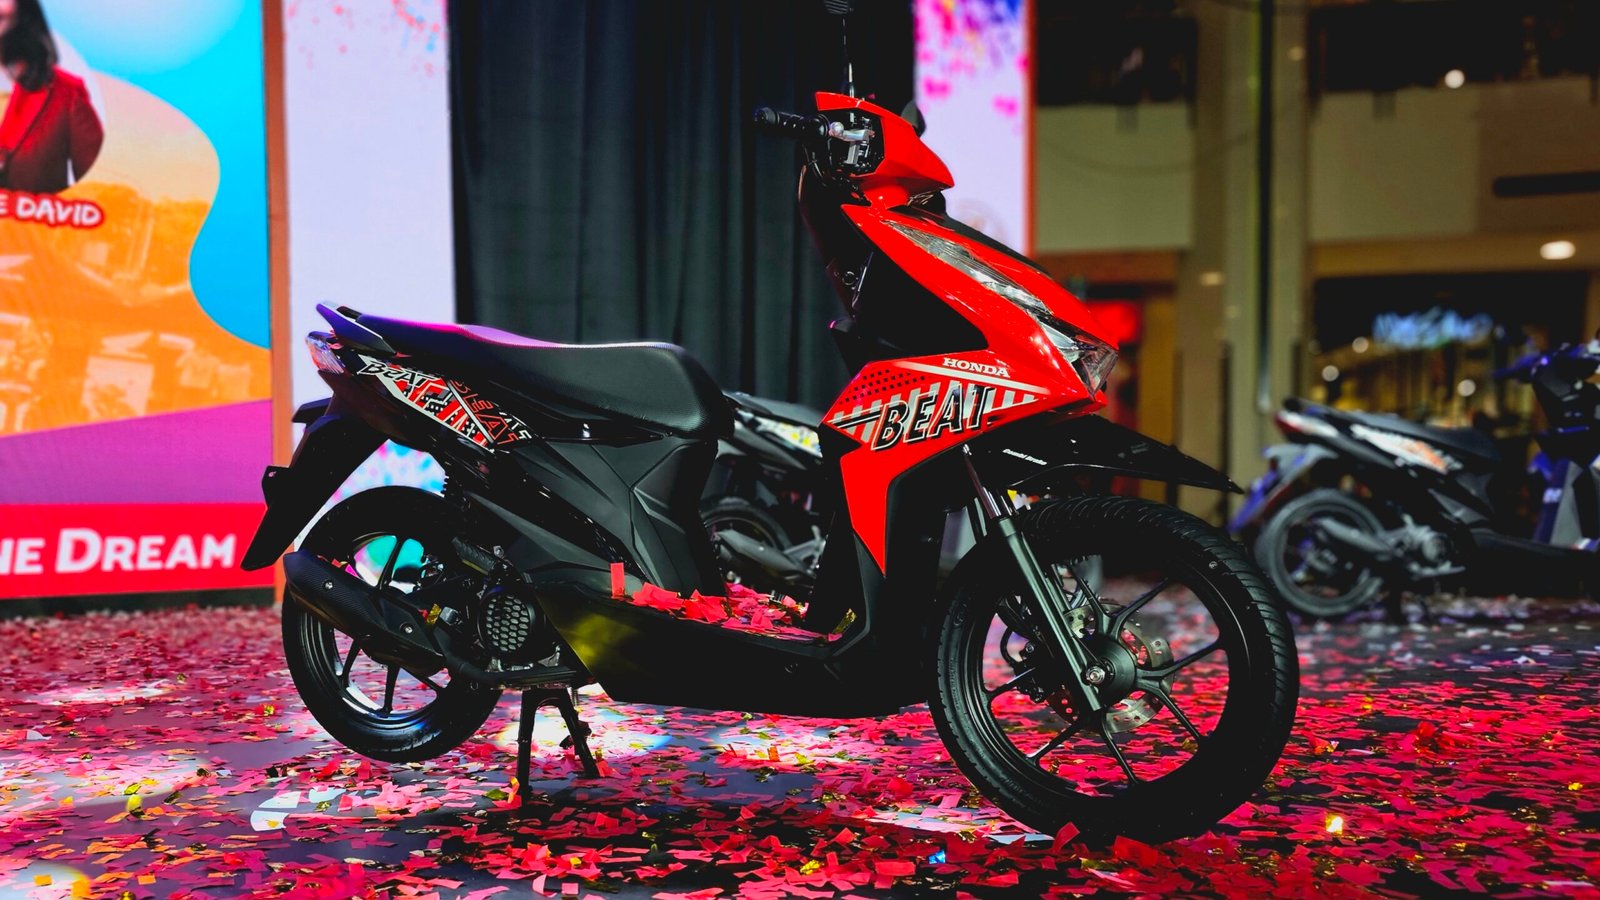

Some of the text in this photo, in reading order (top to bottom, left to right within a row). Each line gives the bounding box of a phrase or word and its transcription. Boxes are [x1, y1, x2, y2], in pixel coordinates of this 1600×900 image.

[16, 196, 101, 226] DAVID
[942, 357, 1011, 379] HONDA
[871, 382, 996, 451] BEAT
